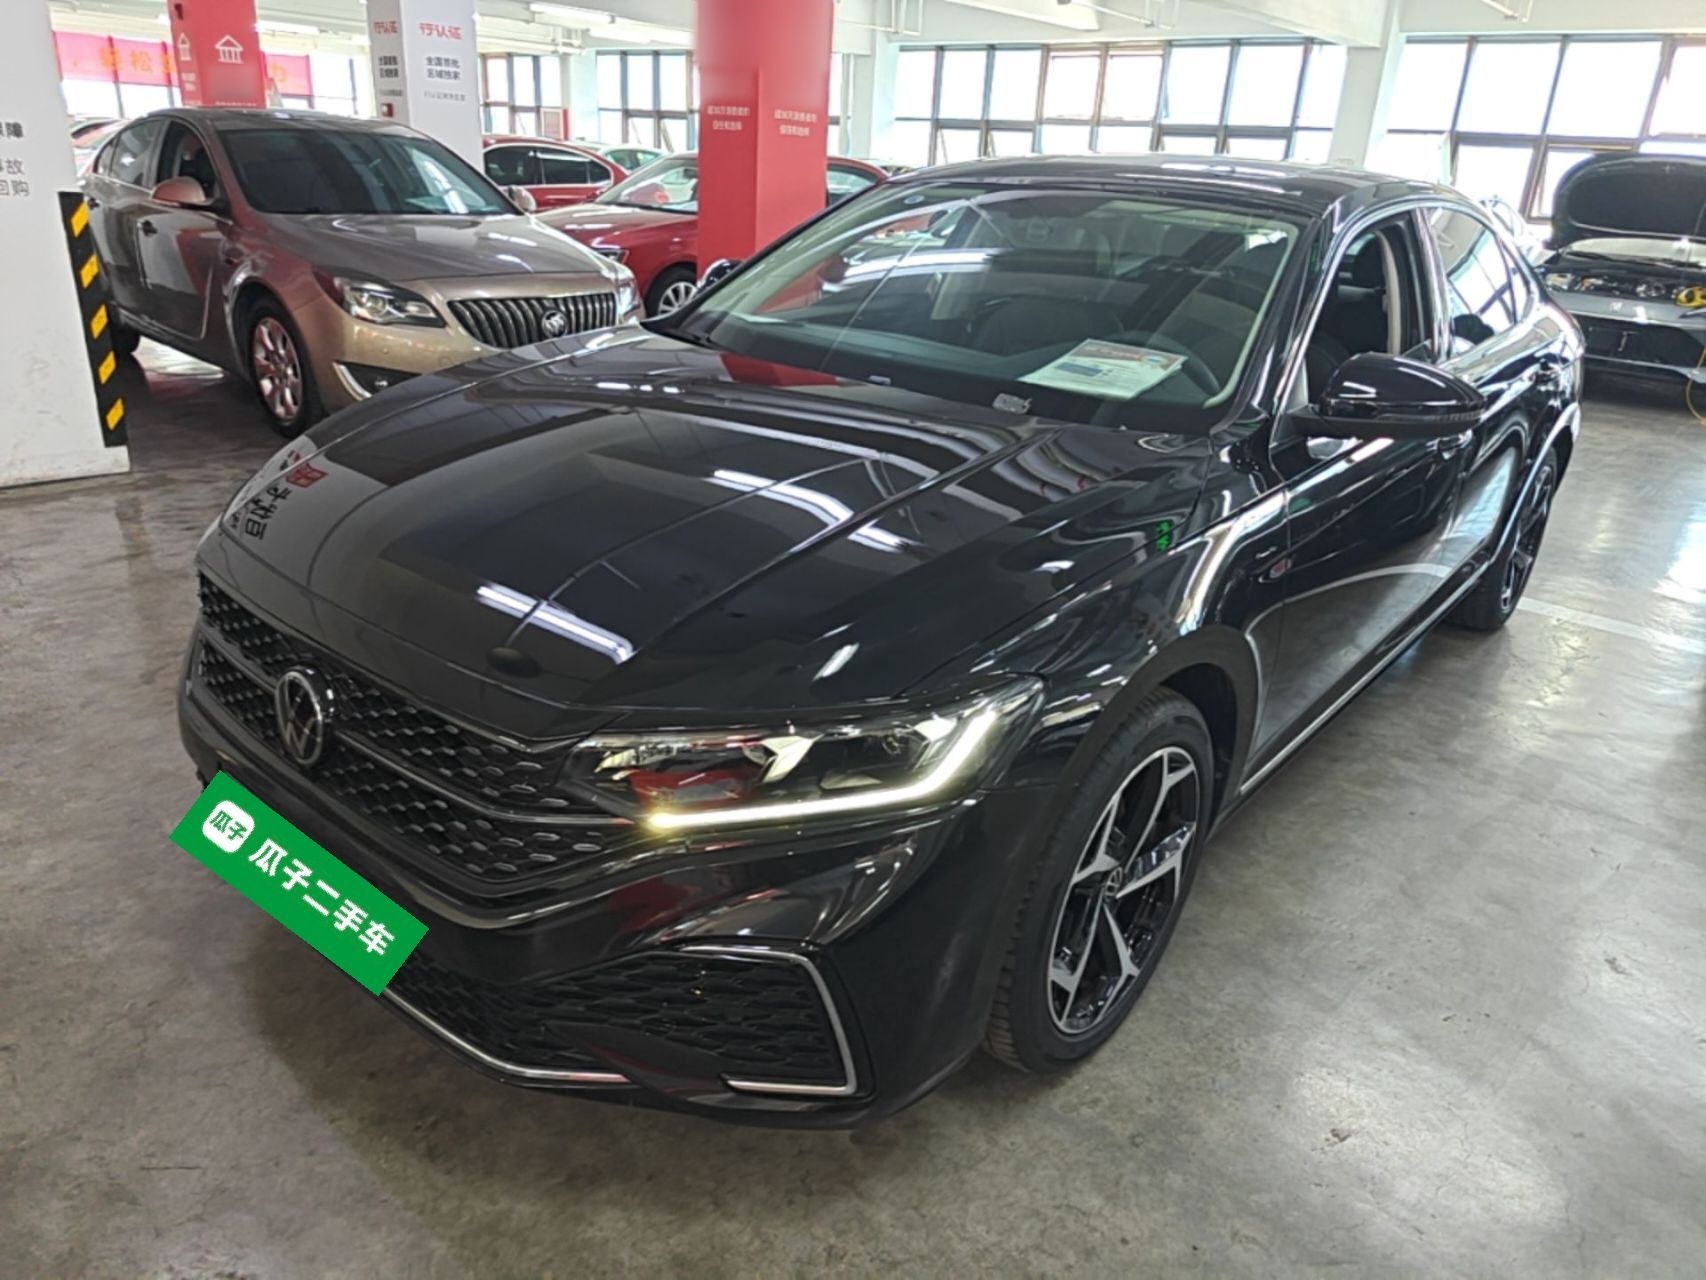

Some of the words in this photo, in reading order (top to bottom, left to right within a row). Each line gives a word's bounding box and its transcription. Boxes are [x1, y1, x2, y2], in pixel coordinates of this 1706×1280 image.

[418, 22, 462, 40] 行认证
[0, 121, 24, 138] 障
[0, 158, 25, 175] 故
